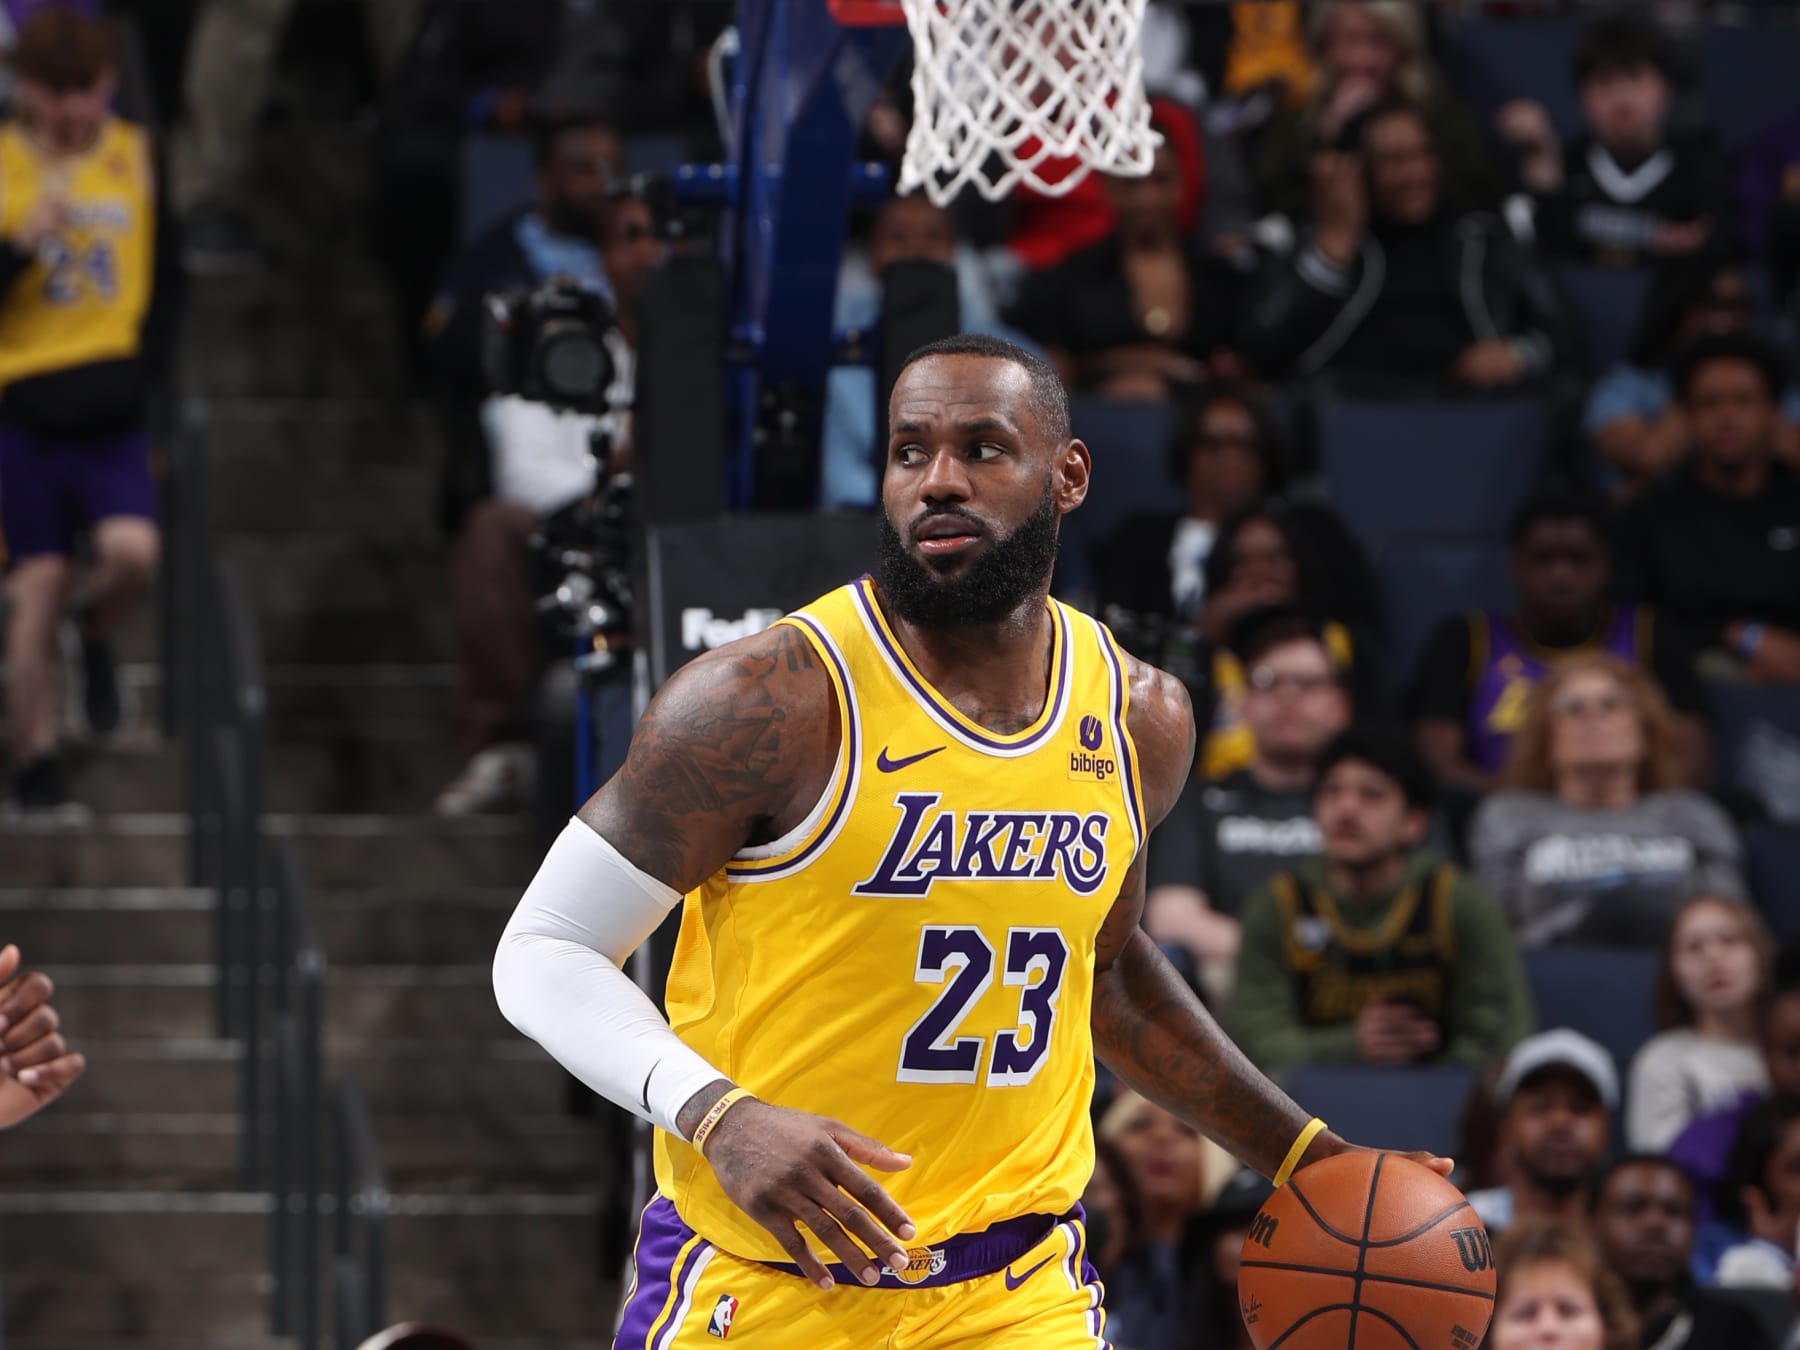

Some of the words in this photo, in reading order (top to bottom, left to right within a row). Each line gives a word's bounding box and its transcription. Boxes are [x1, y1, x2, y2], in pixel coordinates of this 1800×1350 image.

[1070, 752, 1115, 780] bibigo
[850, 791, 1111, 898] LAKERS
[896, 925, 1071, 1088] 23
[696, 1101, 727, 1143] PROMISE
